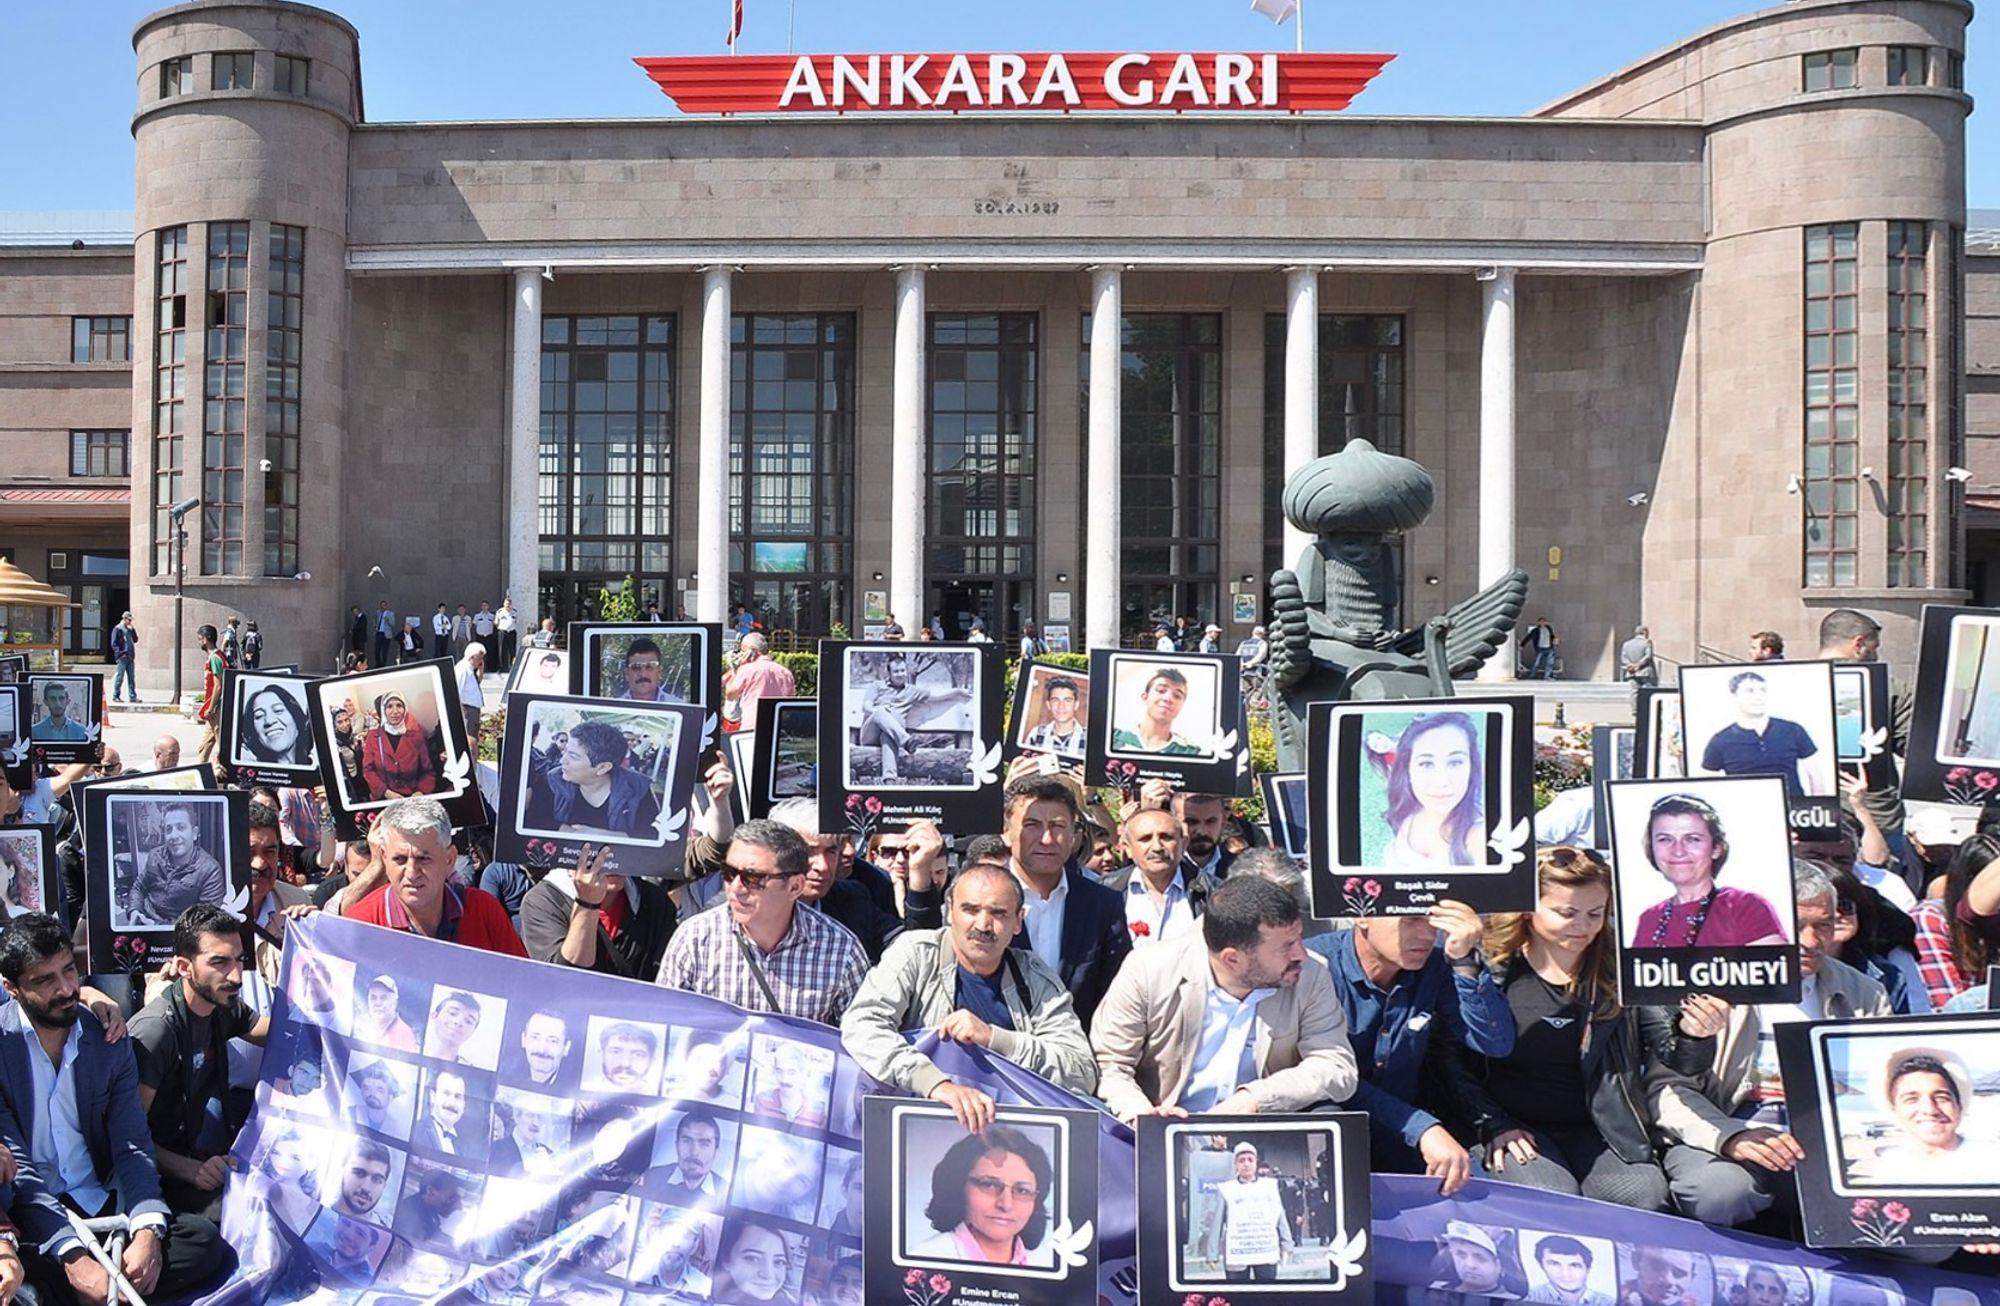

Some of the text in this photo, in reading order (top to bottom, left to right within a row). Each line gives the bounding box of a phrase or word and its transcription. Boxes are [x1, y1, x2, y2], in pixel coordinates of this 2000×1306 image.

[778, 53, 1279, 107] ANKARA GARI
[1395, 881, 1424, 891] Başak
[1633, 955, 1788, 988] İDİL GÜNEYİ
[960, 1286, 1019, 1300] Emine Ercan
